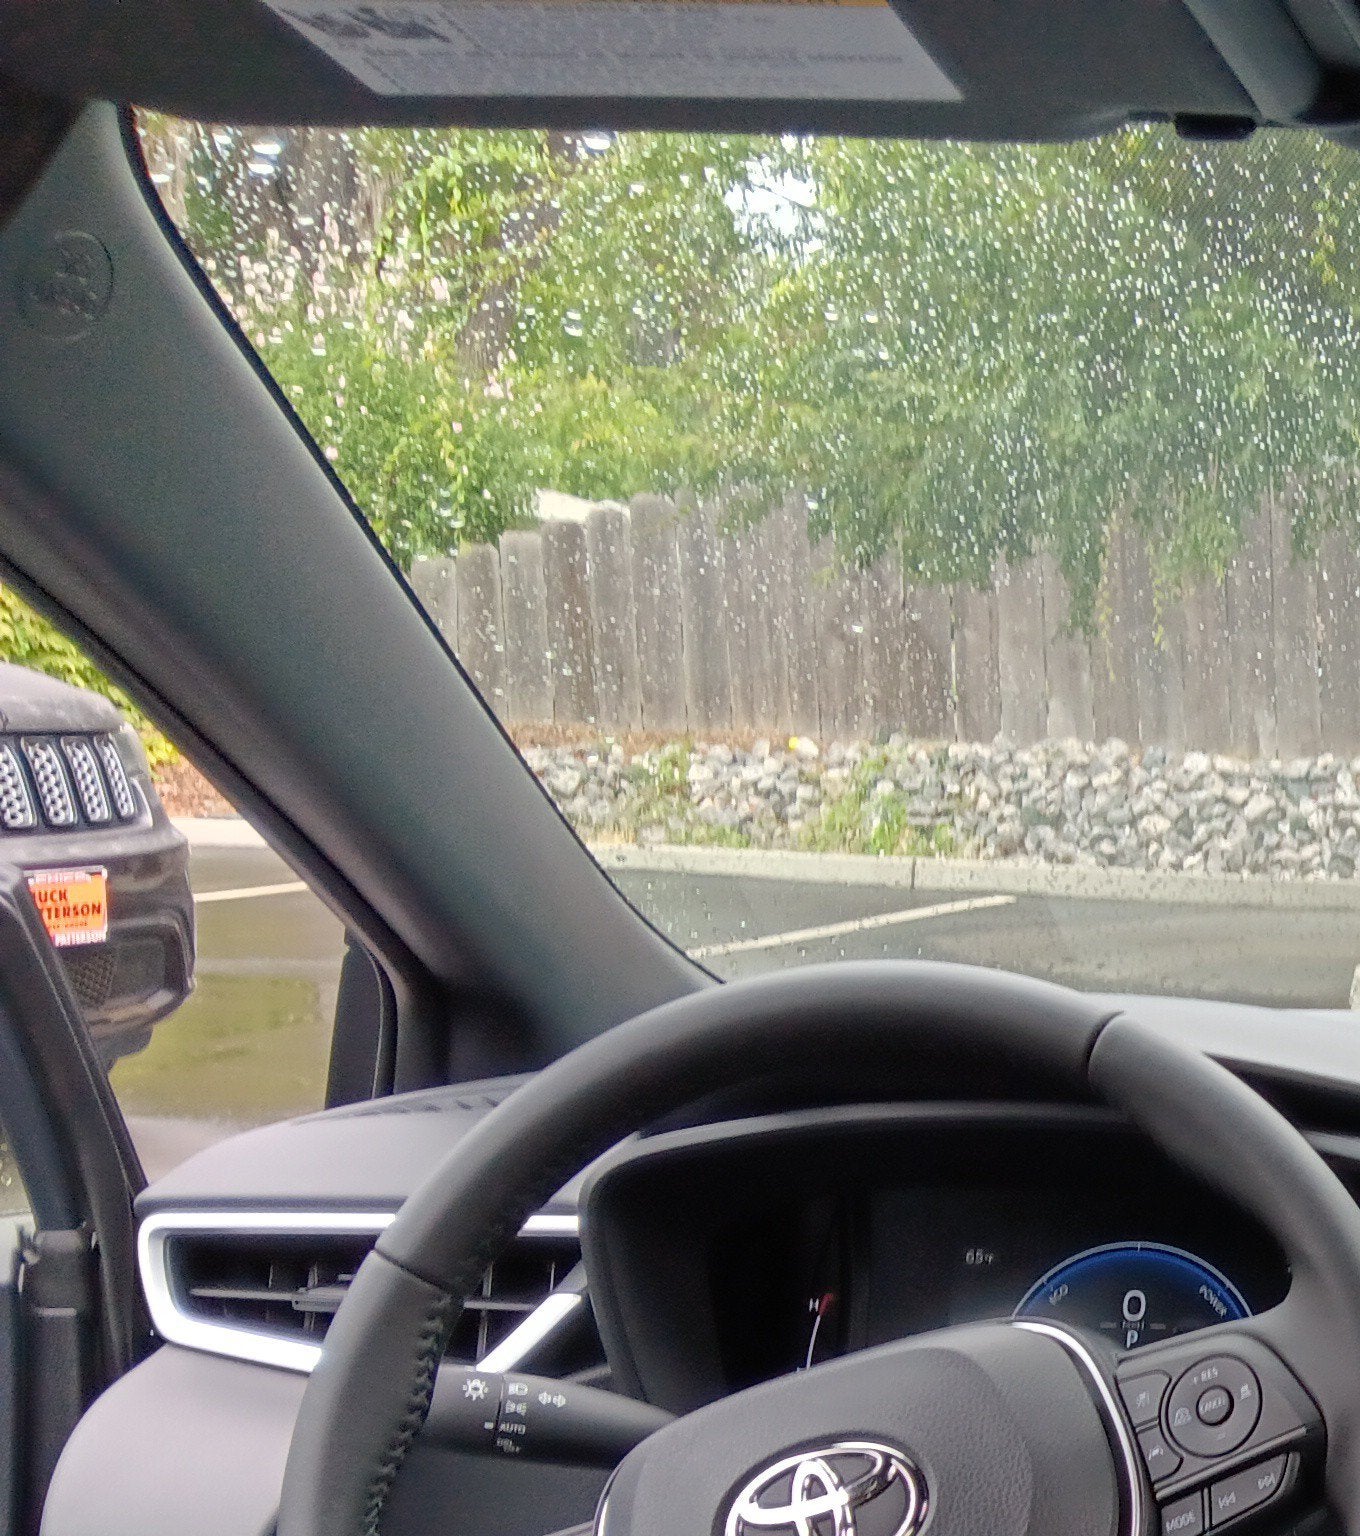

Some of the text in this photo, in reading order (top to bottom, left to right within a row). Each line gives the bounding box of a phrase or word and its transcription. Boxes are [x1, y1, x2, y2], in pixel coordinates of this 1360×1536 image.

[1126, 1329, 1139, 1348] P
[499, 1421, 526, 1436] AUTO
[1165, 1510, 1198, 1535] MODE
